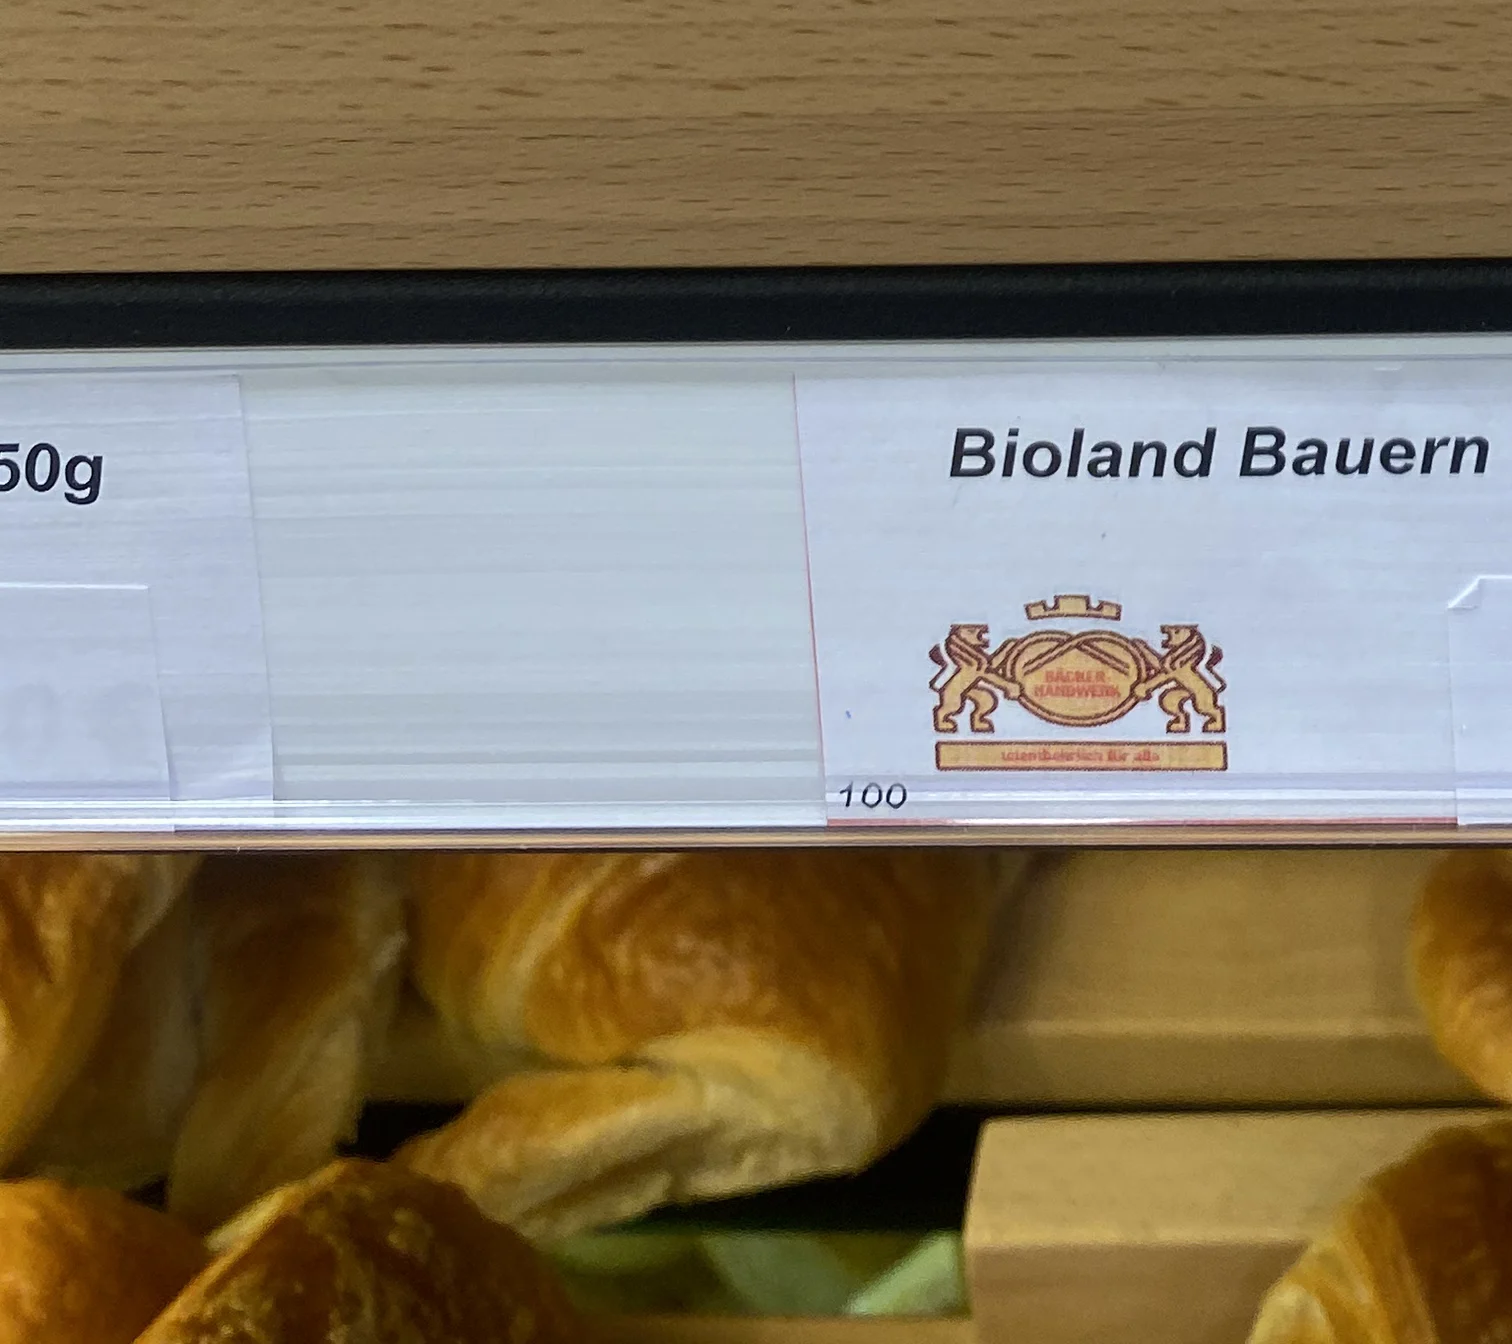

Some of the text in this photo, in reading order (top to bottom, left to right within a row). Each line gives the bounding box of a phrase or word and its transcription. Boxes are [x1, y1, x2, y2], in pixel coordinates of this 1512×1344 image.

[949, 426, 1217, 479] Bioland
[1239, 426, 1489, 477] Bauern
[839, 781, 907, 809] 100
